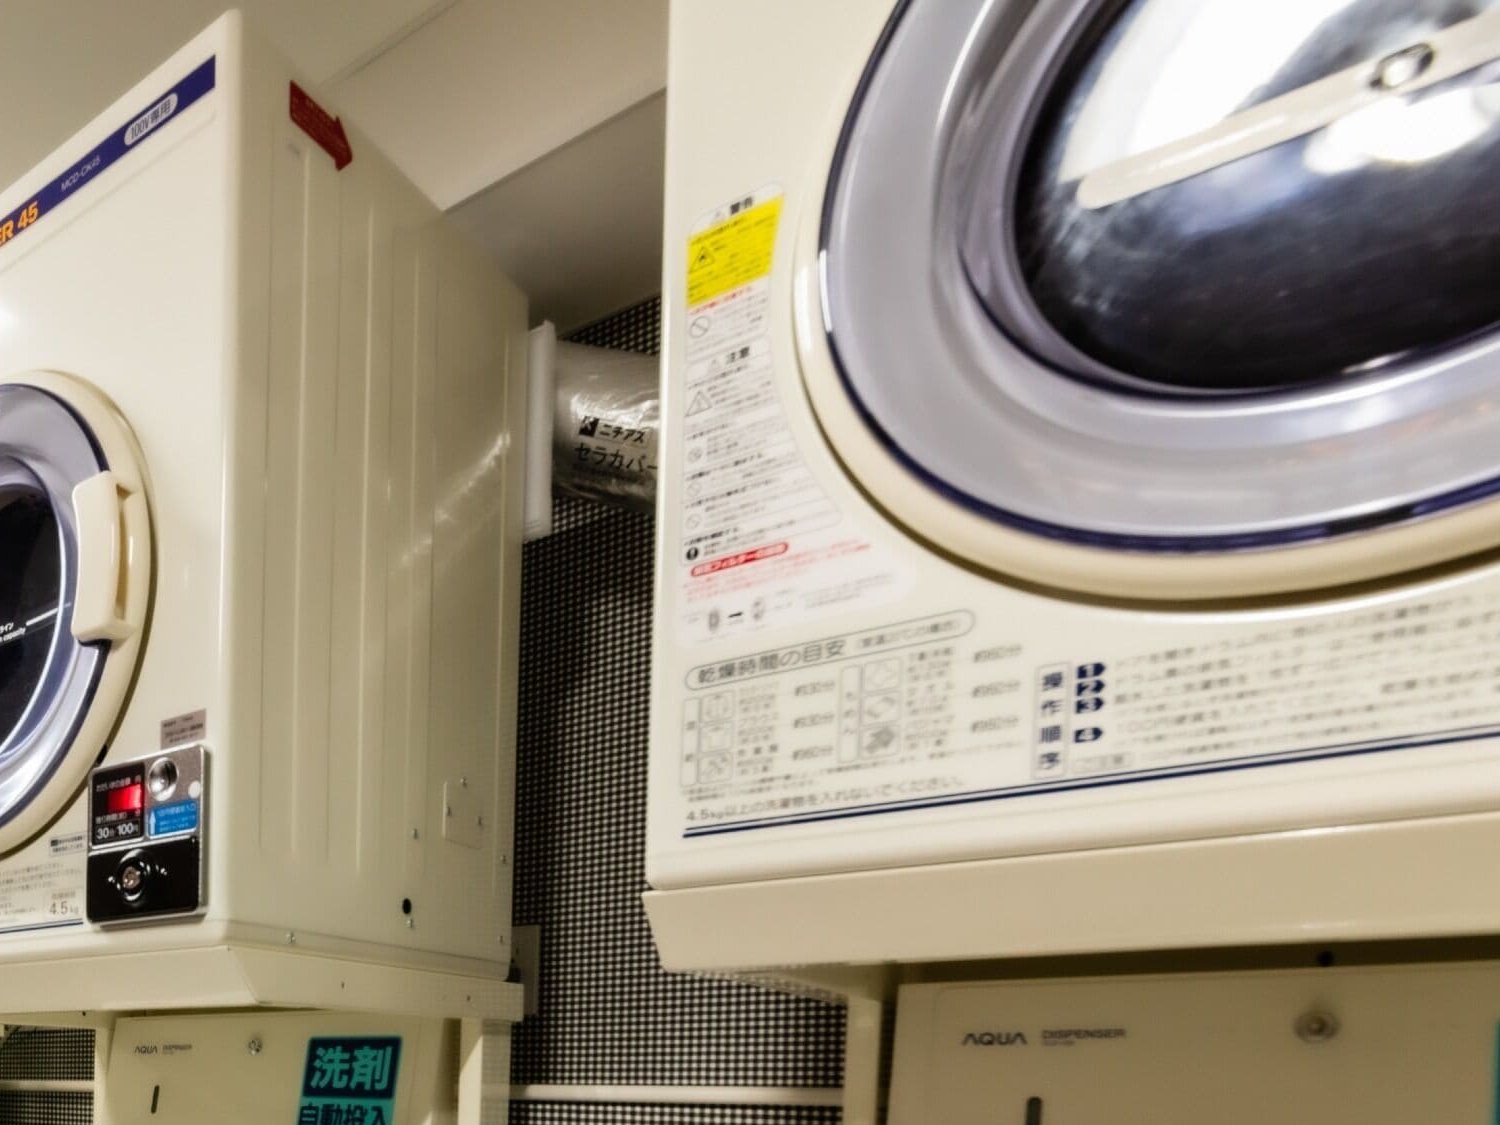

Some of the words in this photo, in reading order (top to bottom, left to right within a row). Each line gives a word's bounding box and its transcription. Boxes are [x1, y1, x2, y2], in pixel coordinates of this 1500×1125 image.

[17, 200, 39, 229] 45
[698, 640, 847, 685] 乾燥時間の目安
[961, 1031, 1028, 1046] AQUA
[309, 1045, 393, 1091] 洗剤
